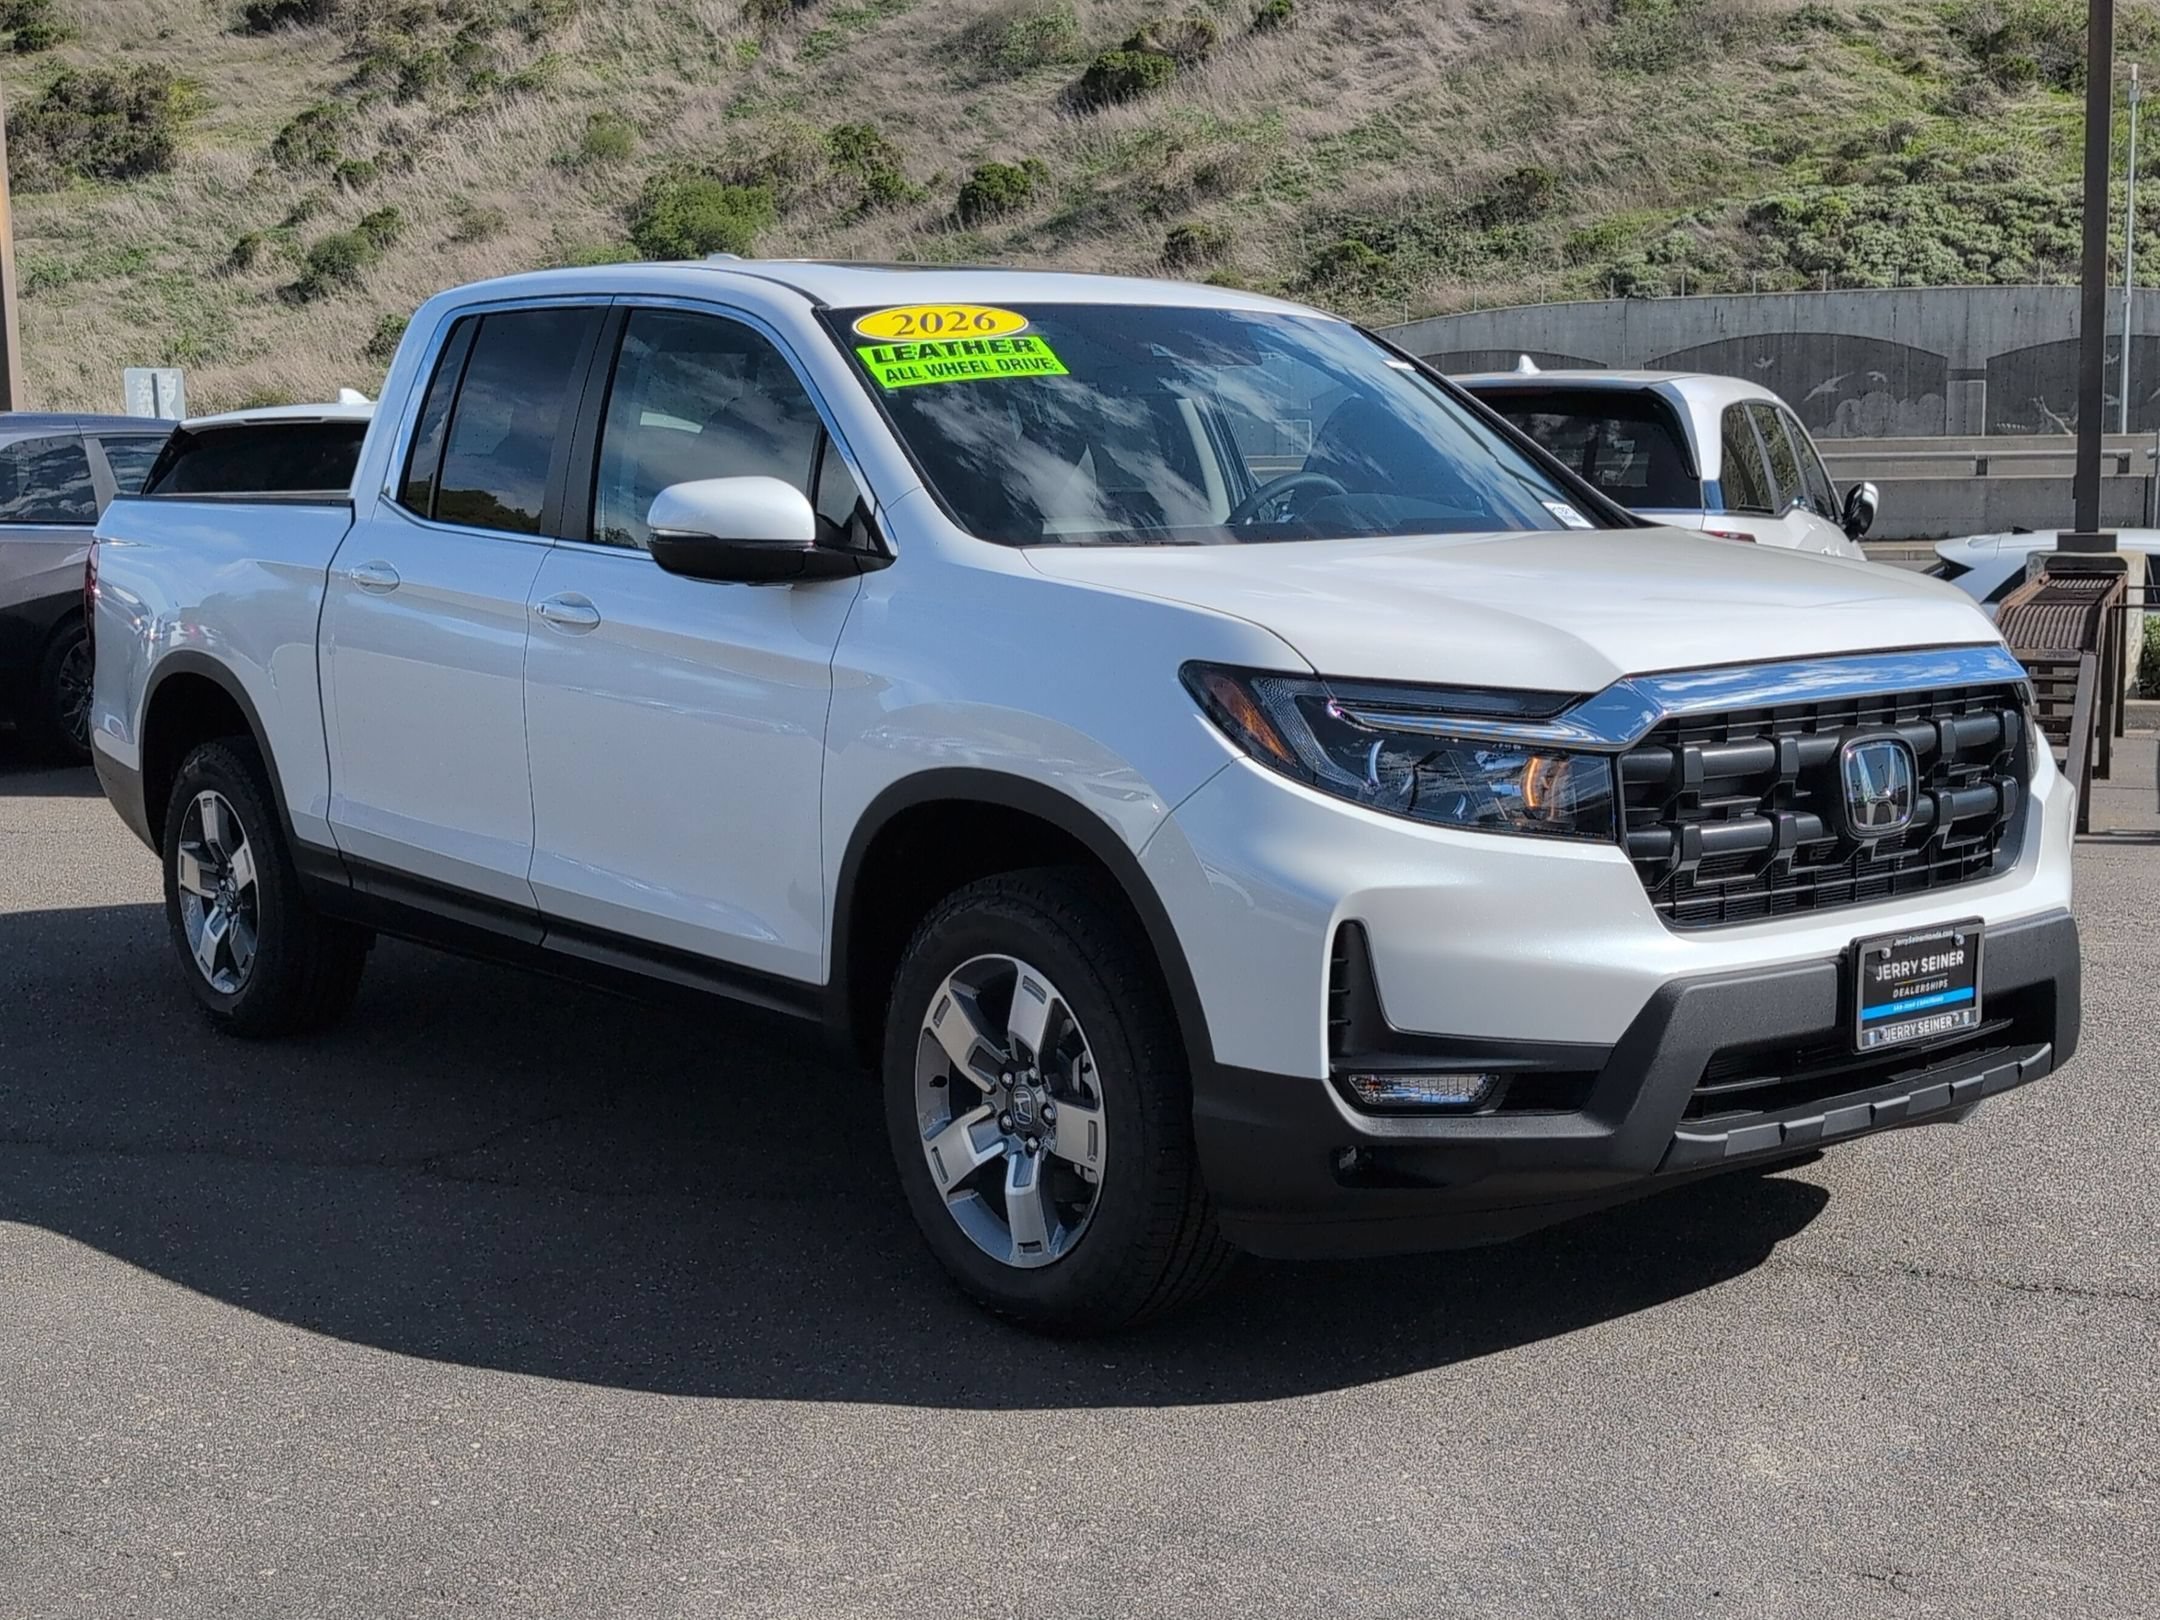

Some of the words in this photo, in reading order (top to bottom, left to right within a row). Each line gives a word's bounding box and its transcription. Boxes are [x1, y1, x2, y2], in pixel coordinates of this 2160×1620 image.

[892, 311, 996, 337] 2026
[871, 339, 1036, 364] LEATHER
[886, 365, 922, 383] ALL
[927, 360, 993, 378] WHEEL
[1000, 357, 1052, 371] DRIVE
[1876, 959, 1919, 982] JERRY
[1921, 950, 1964, 973] SEINER
[1893, 979, 1948, 998] DEALERSHIPS
[1885, 1024, 1917, 1041] JERRY
[1918, 1014, 1952, 1035] SEINER
